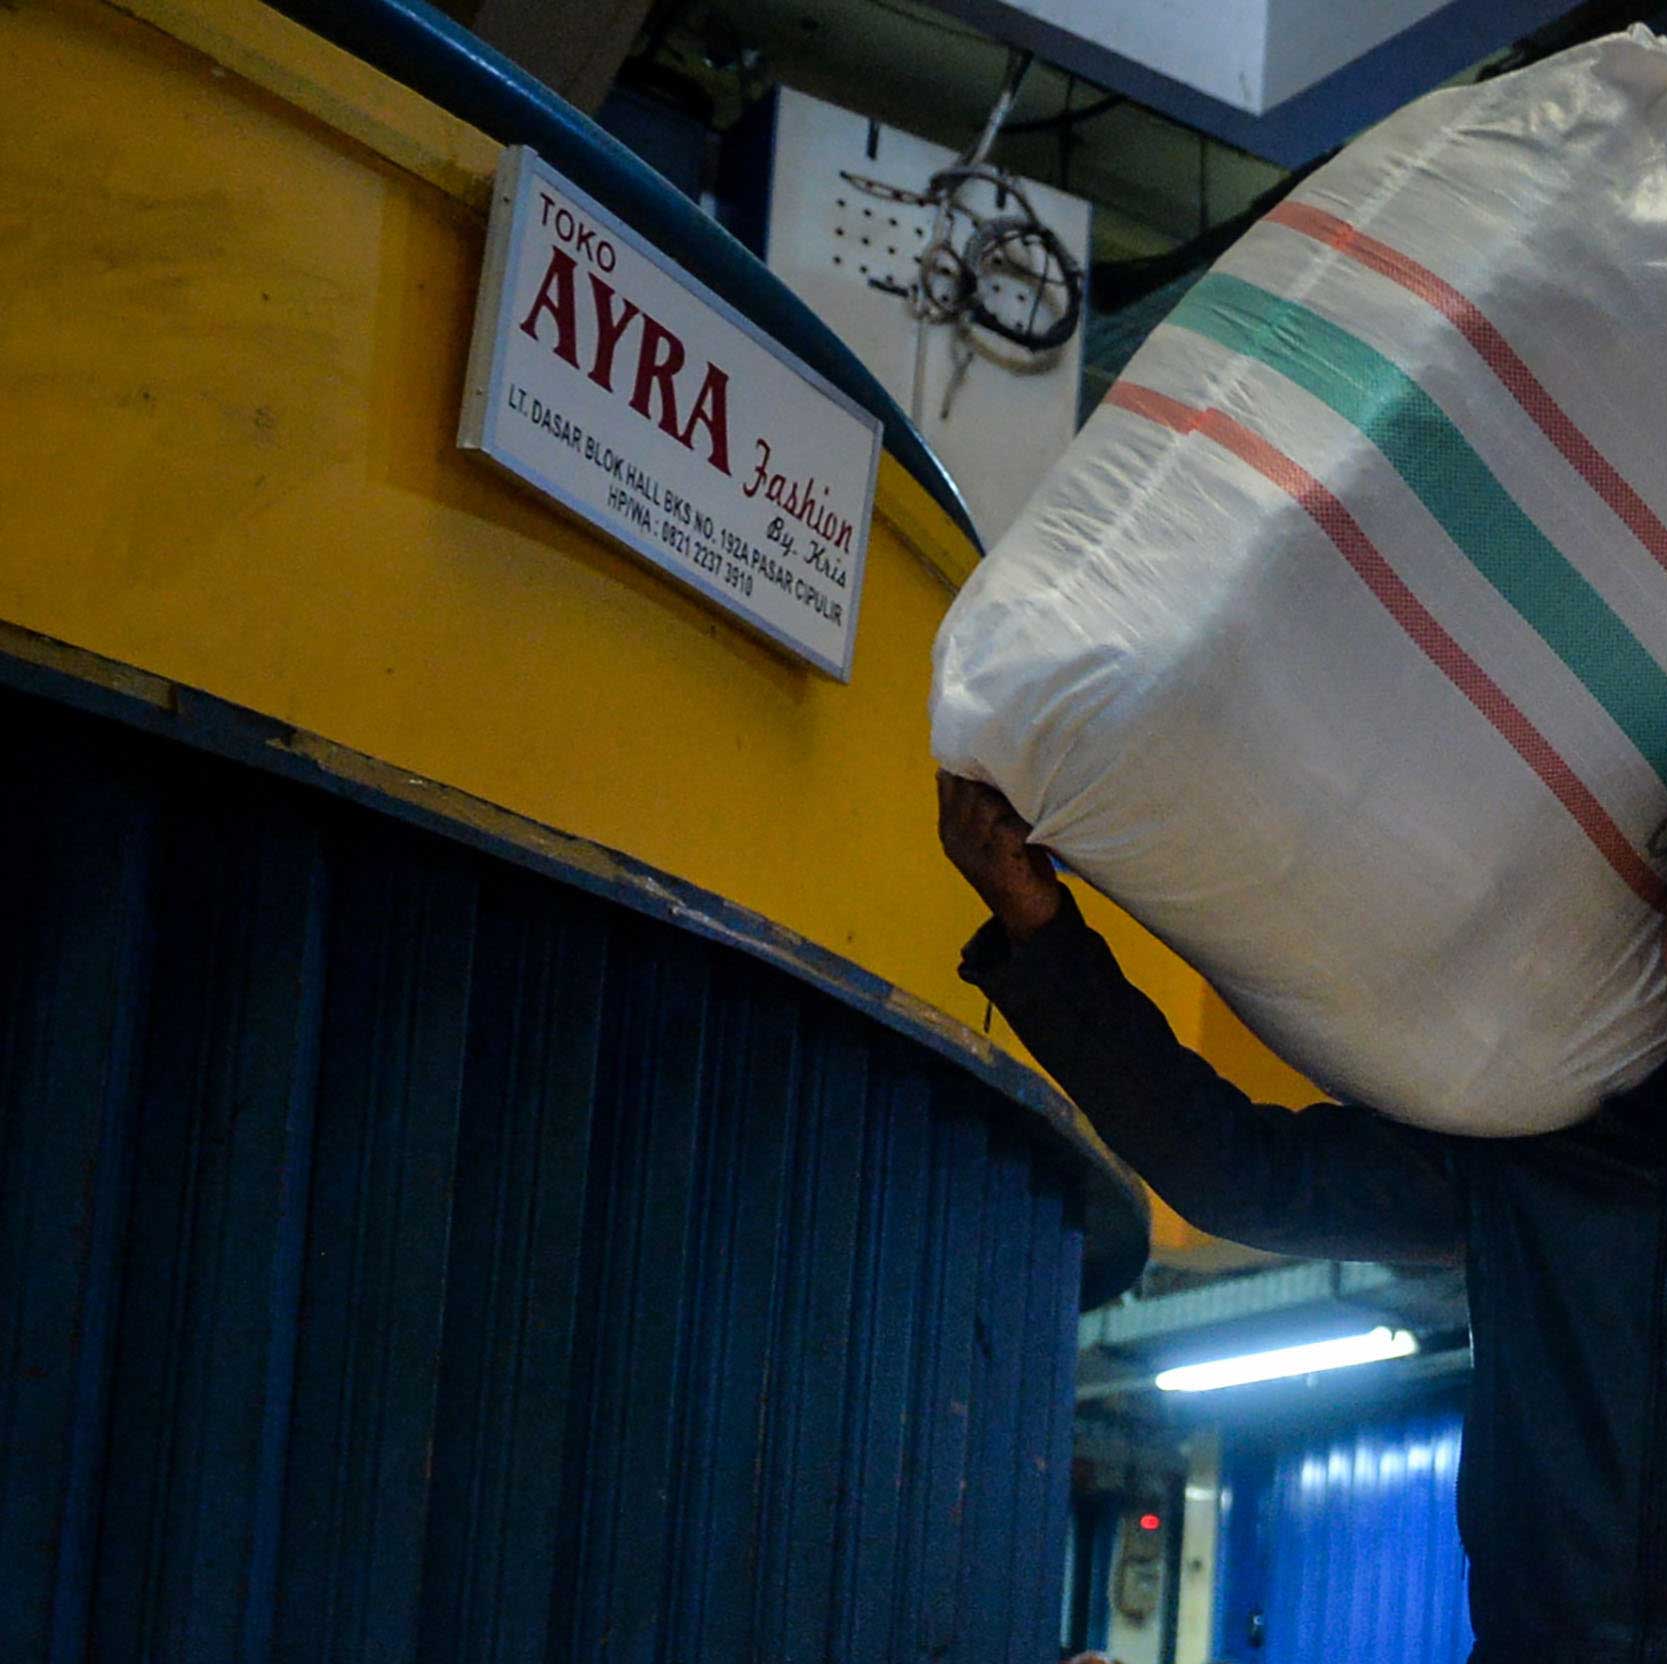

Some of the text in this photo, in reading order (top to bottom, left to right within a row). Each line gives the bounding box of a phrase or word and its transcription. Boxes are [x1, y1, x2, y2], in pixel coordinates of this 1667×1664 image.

[540, 191, 617, 274] TOKO
[519, 245, 732, 478] AYRA
[508, 382, 528, 417] LT.
[531, 400, 583, 456] DASAR
[584, 429, 625, 481] BLOK
[626, 459, 661, 508] HALL
[664, 483, 693, 526] BKS
[750, 546, 794, 596] PASAR
[794, 574, 844, 628] CIPULIR
[742, 437, 854, 556] Fashion
[661, 518, 693, 562] 0821
[693, 539, 723, 580] 2237
[724, 557, 754, 600] 3910
[803, 540, 847, 590] Kris
